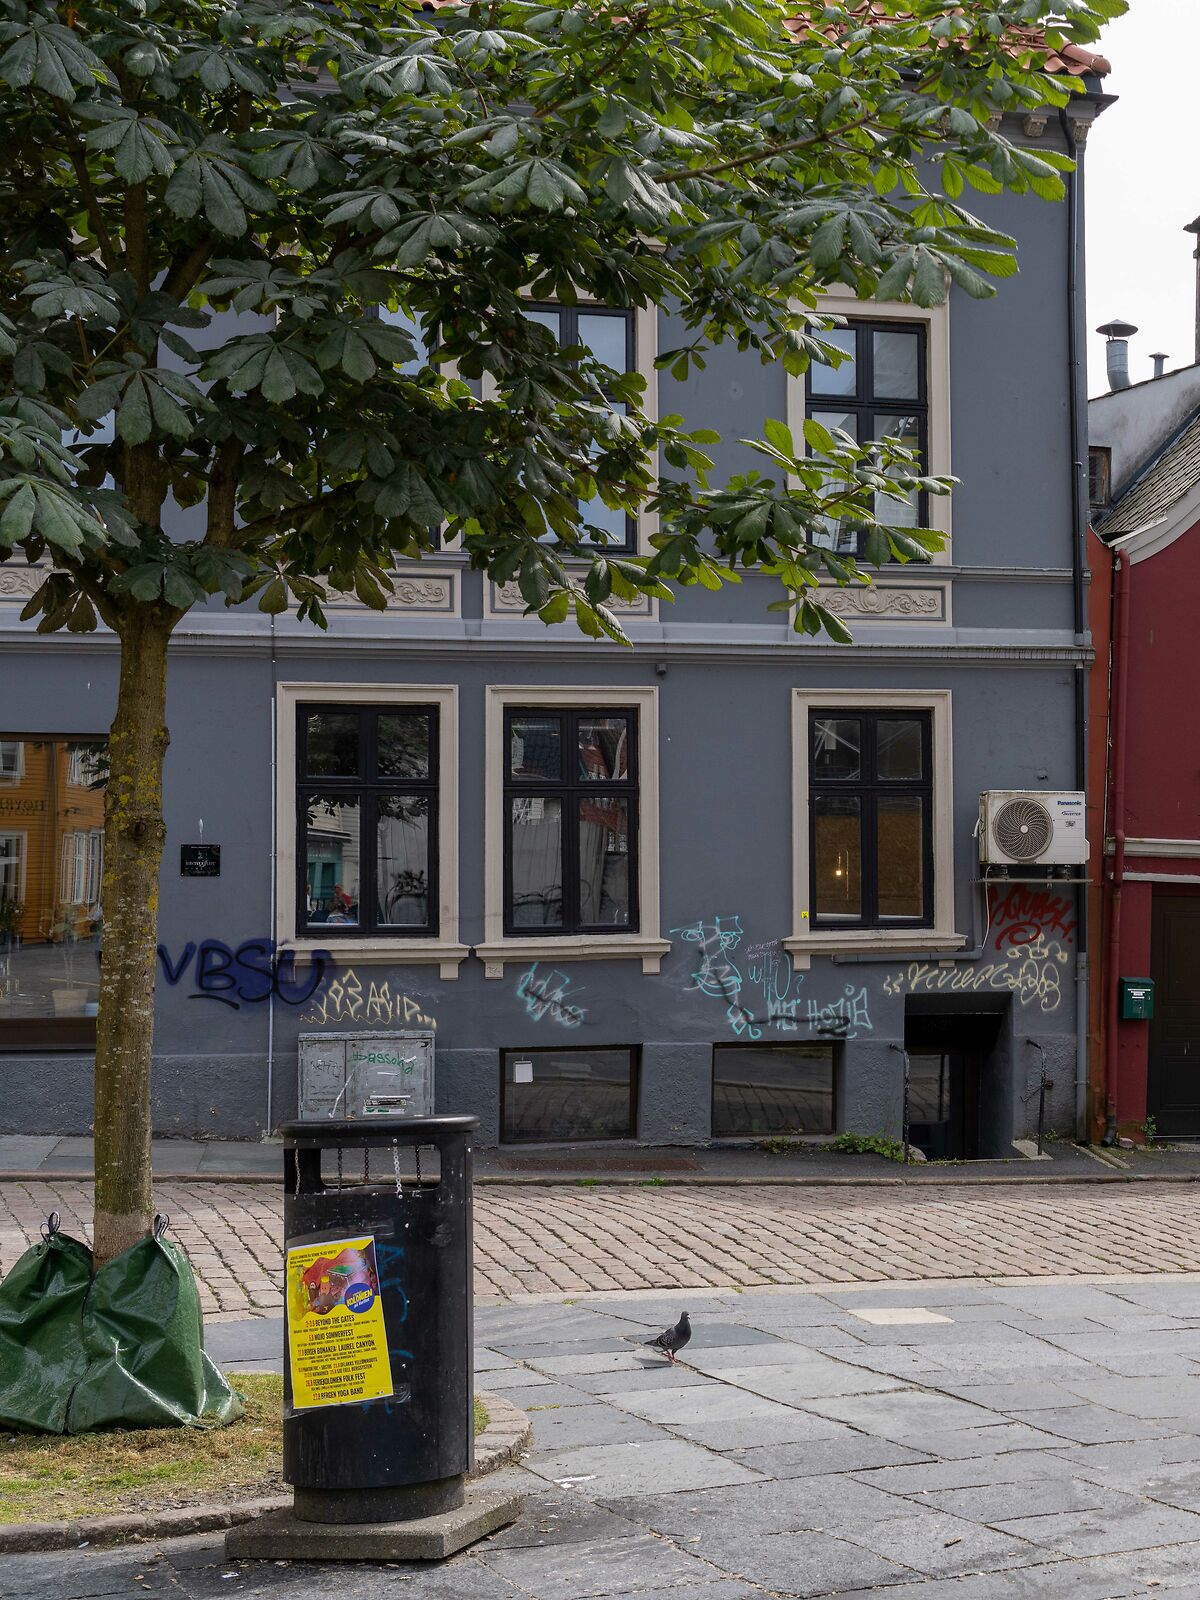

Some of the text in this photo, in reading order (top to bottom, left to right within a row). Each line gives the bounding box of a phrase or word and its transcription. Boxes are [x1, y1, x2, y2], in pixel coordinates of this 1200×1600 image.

[331, 1316, 341, 1324] THE
[340, 1314, 355, 1324] GATES
[355, 1340, 376, 1349] CANYON
[342, 1374, 354, 1383] FOLK
[354, 1372, 366, 1380] FEST
[337, 1388, 350, 1397] YOGA
[350, 1386, 364, 1396] BAND
